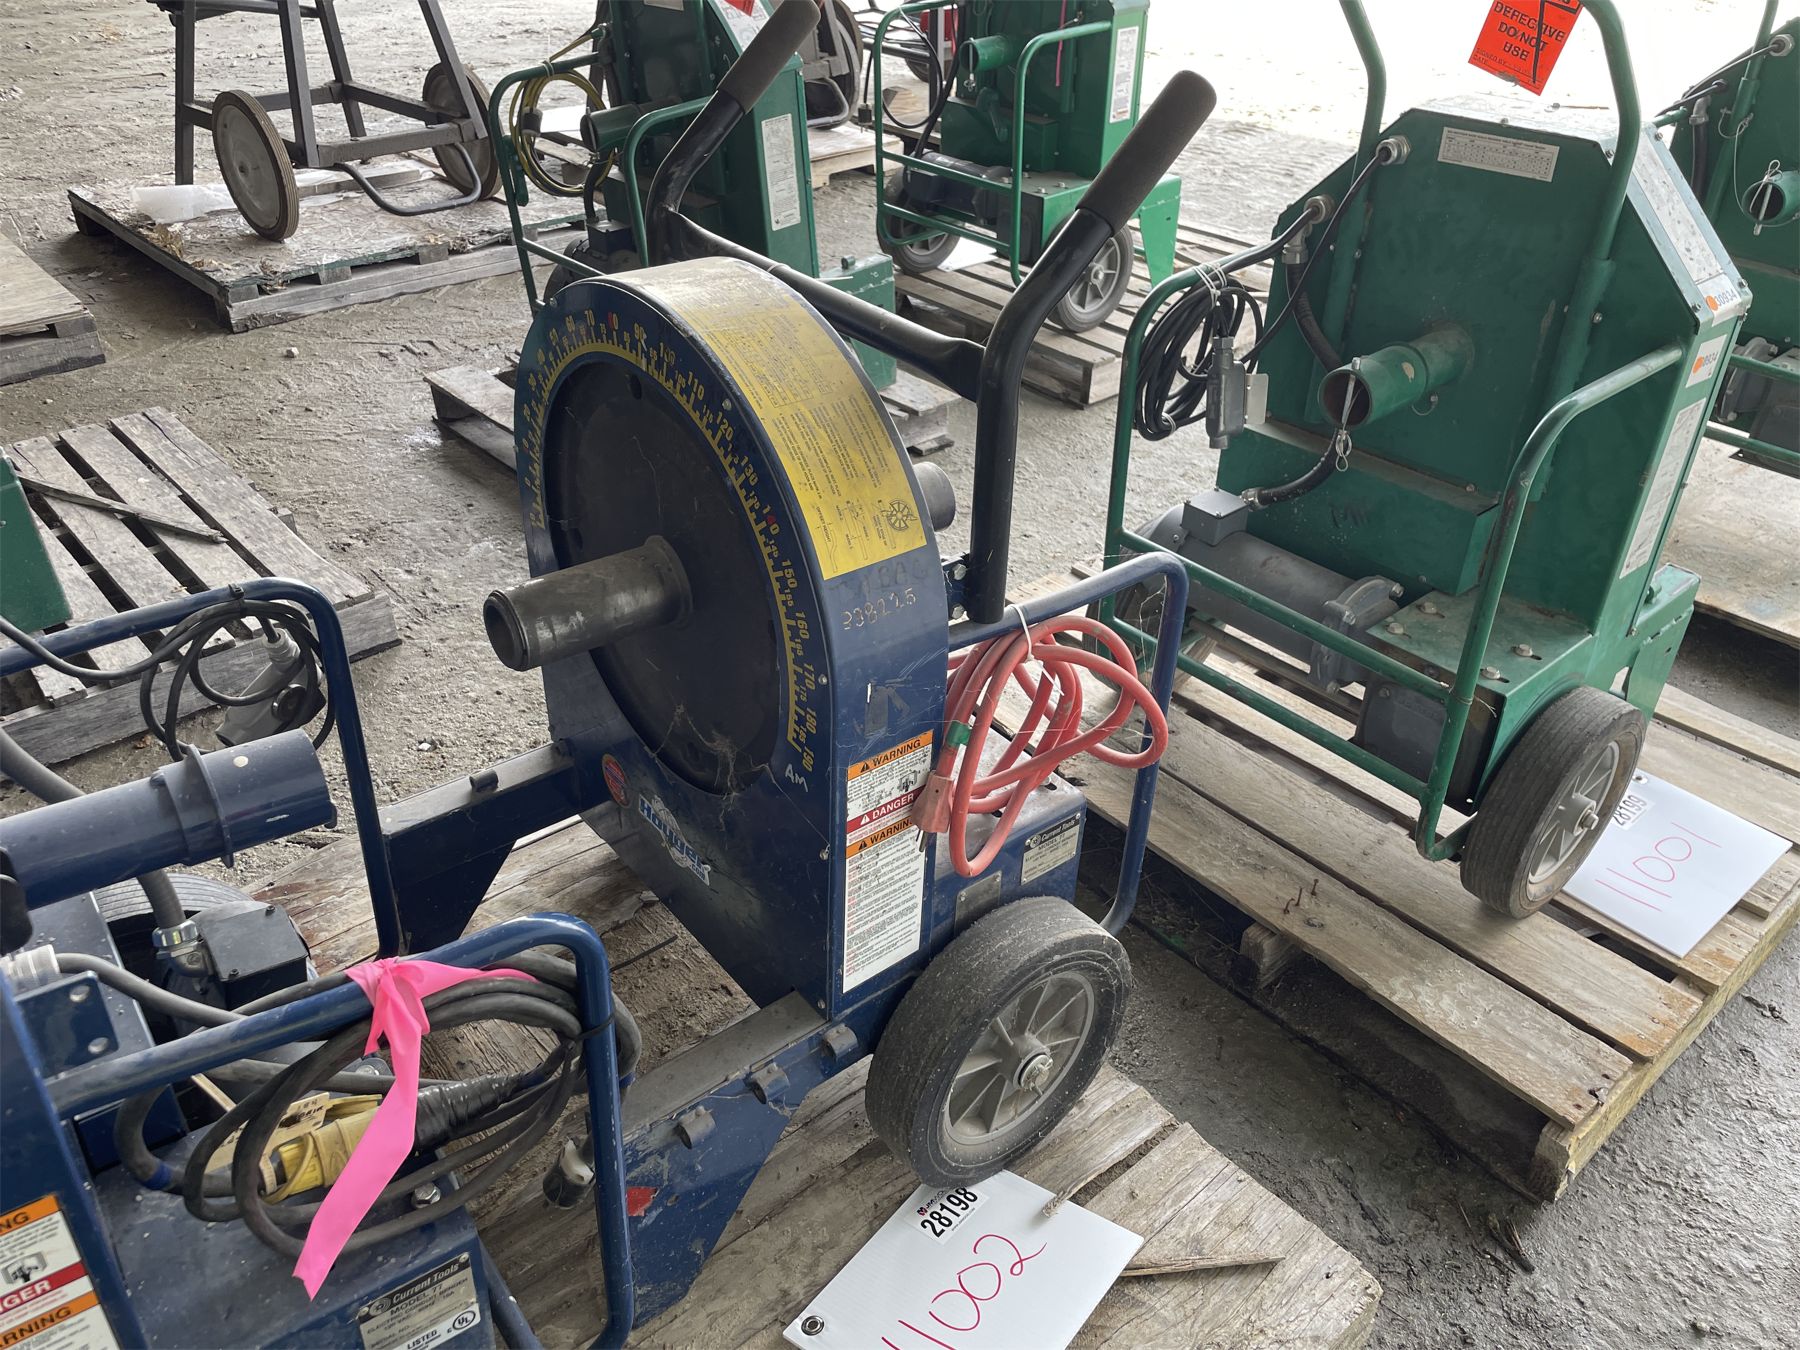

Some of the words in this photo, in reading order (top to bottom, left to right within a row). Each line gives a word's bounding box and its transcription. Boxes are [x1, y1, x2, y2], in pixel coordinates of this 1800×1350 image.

[1503, 41, 1530, 61] USE
[584, 309, 595, 326] 70
[634, 322, 646, 340] 90
[688, 372, 704, 400] 110
[717, 412, 733, 441] 120
[741, 456, 759, 486] 130
[782, 560, 798, 588] 150
[796, 611, 810, 640] 160
[804, 663, 815, 690] 170
[806, 707, 817, 734] 180
[802, 746, 814, 772] 190
[872, 738, 921, 767] WARNING
[872, 792, 914, 820] DANGER
[1614, 794, 1648, 826] 28199
[870, 819, 912, 844] WARNIN
[1038, 839, 1058, 850] MODEL
[1595, 822, 1722, 912] 11001
[920, 1187, 978, 1238] 28198
[0, 1280, 52, 1312] GER
[393, 1279, 430, 1303] Current
[433, 1263, 459, 1284] Tools
[390, 1292, 429, 1315] MODEL
[433, 1284, 442, 1293] 77
[0, 1306, 72, 1347] RNING
[458, 1316, 469, 1327] UL
[407, 1329, 437, 1350] LISTED
